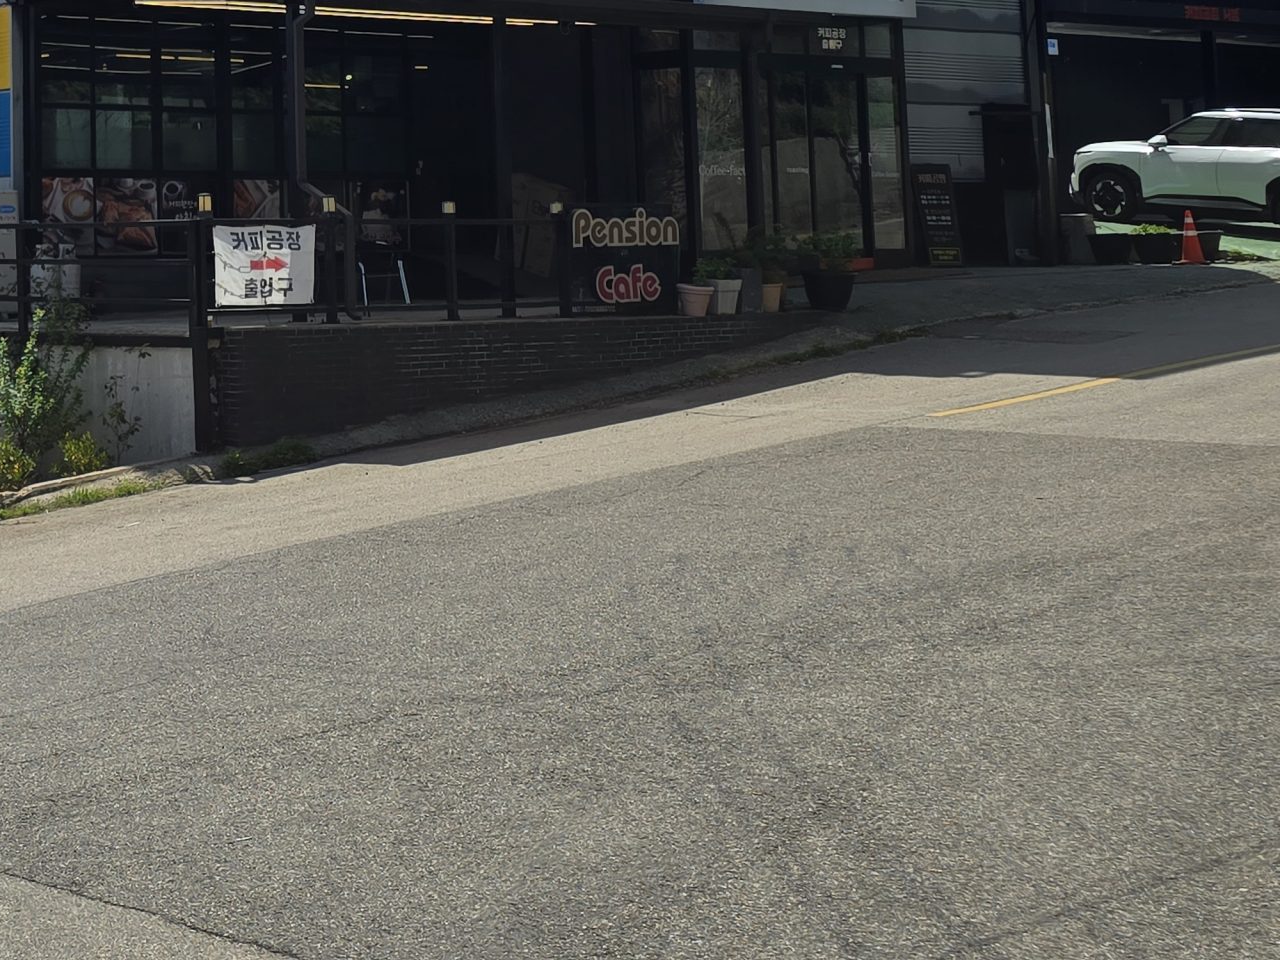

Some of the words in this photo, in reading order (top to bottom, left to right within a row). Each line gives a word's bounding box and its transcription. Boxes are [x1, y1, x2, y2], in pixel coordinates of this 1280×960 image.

[817, 27, 847, 39] 커피공장
[573, 207, 680, 248] Pension
[230, 230, 301, 251] 커피공장
[244, 277, 293, 299] 출입구
[596, 264, 662, 303] Cafe
